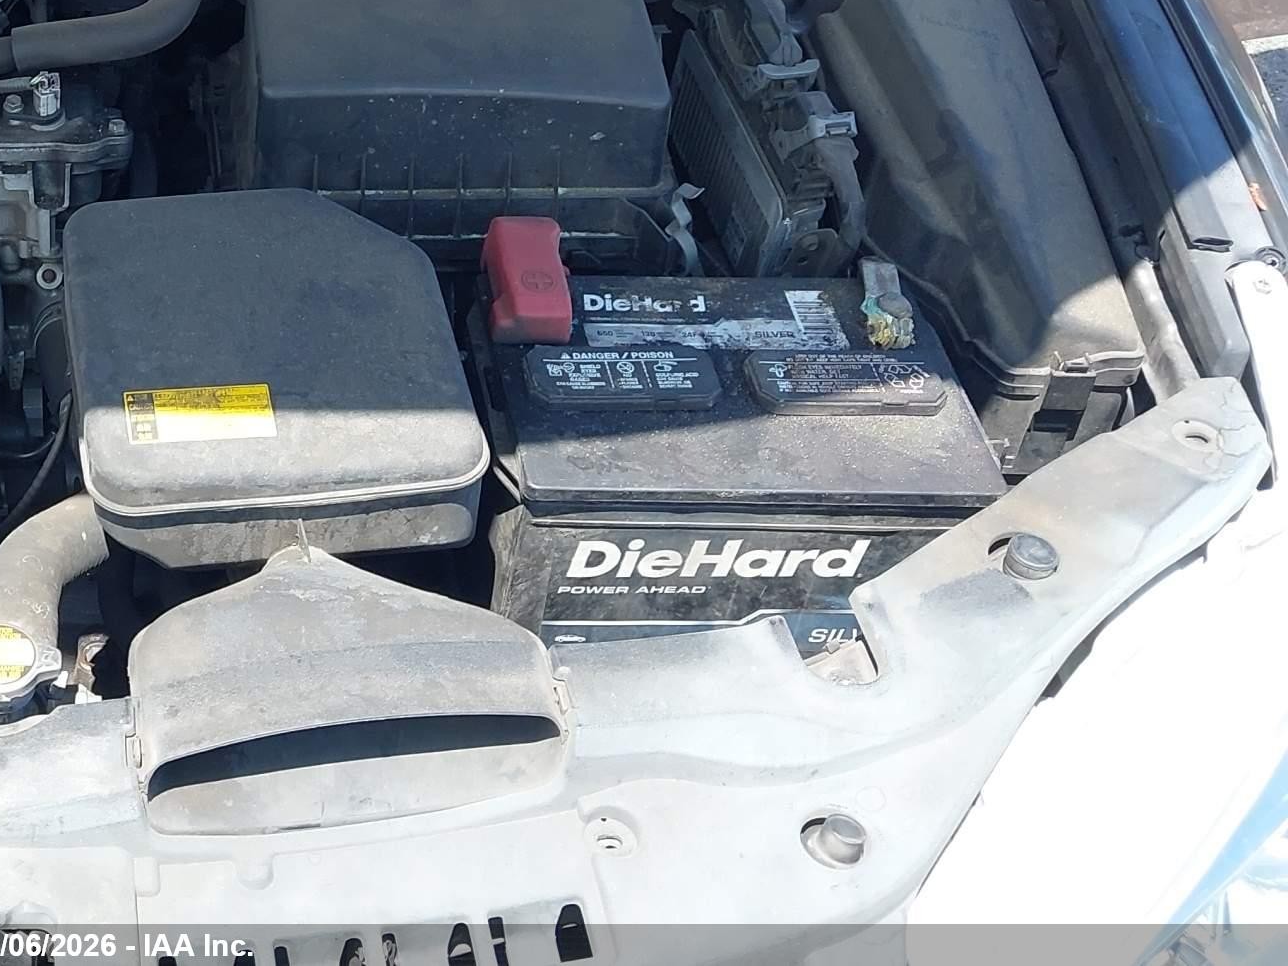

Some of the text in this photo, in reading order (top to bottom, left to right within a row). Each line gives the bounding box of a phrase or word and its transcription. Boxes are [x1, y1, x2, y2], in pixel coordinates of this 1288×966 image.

[754, 330, 795, 339] SILVER
[572, 351, 620, 360] DANGER
[630, 351, 674, 359] POISON
[565, 539, 871, 578] DieHard
[557, 585, 707, 595] POWER AHEAD
